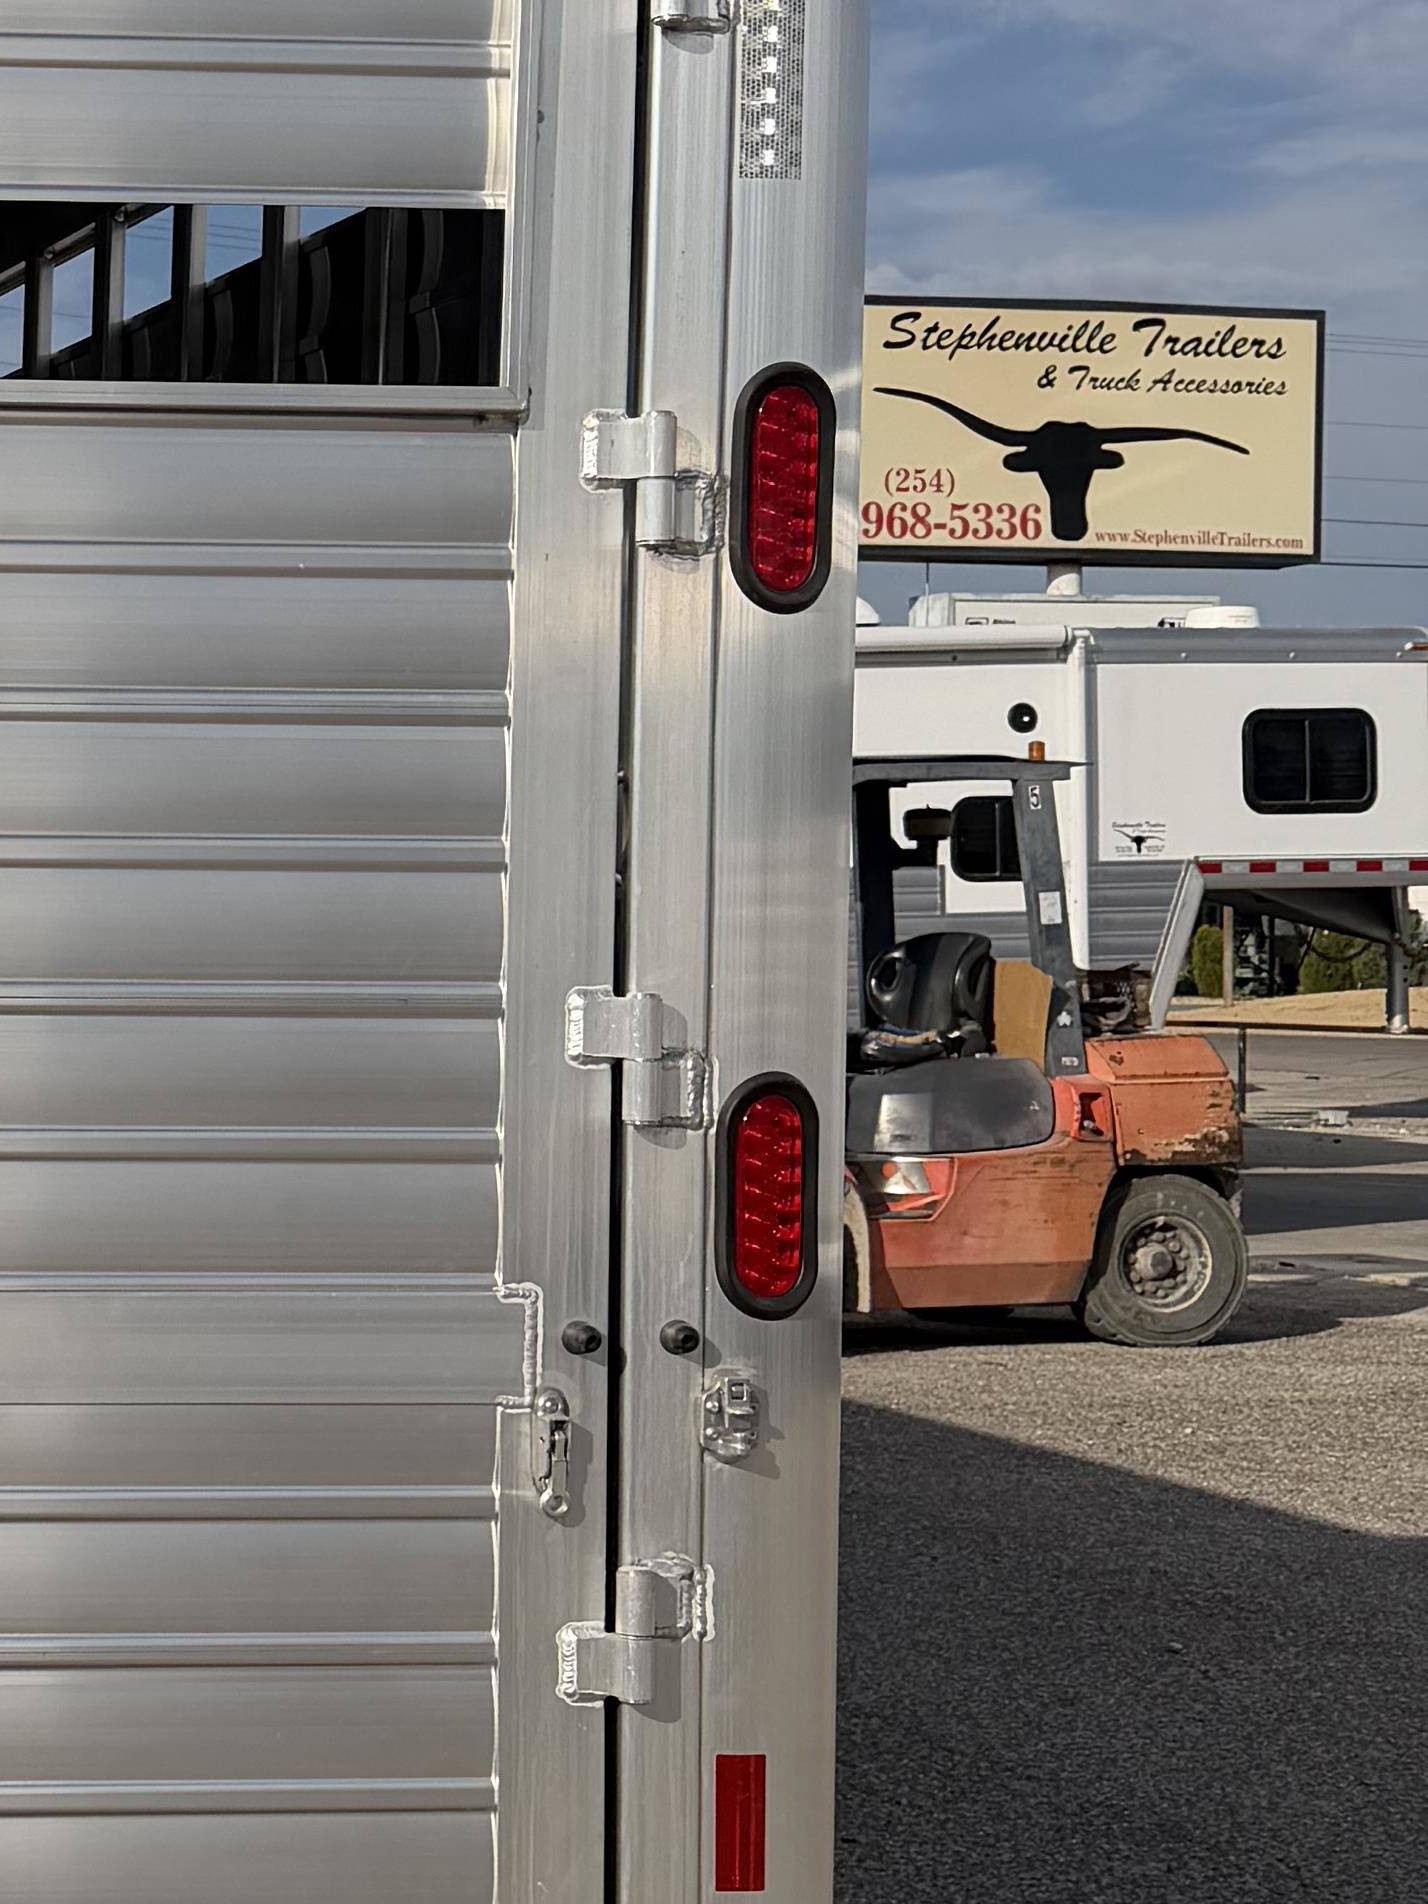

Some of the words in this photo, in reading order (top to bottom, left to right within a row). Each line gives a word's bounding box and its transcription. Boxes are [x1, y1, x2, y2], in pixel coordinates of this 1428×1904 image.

[883, 310, 1117, 361] Stephenville
[1132, 317, 1287, 360] Trailers
[1037, 364, 1056, 389] &
[1068, 366, 1142, 393] Truck
[1147, 370, 1288, 397] Accessories
[884, 467, 956, 496] (254)
[860, 501, 1043, 541] 968-5336
[1095, 529, 1304, 550] www.StephenvilleTrailers.com
[1030, 786, 1040, 808] 5
